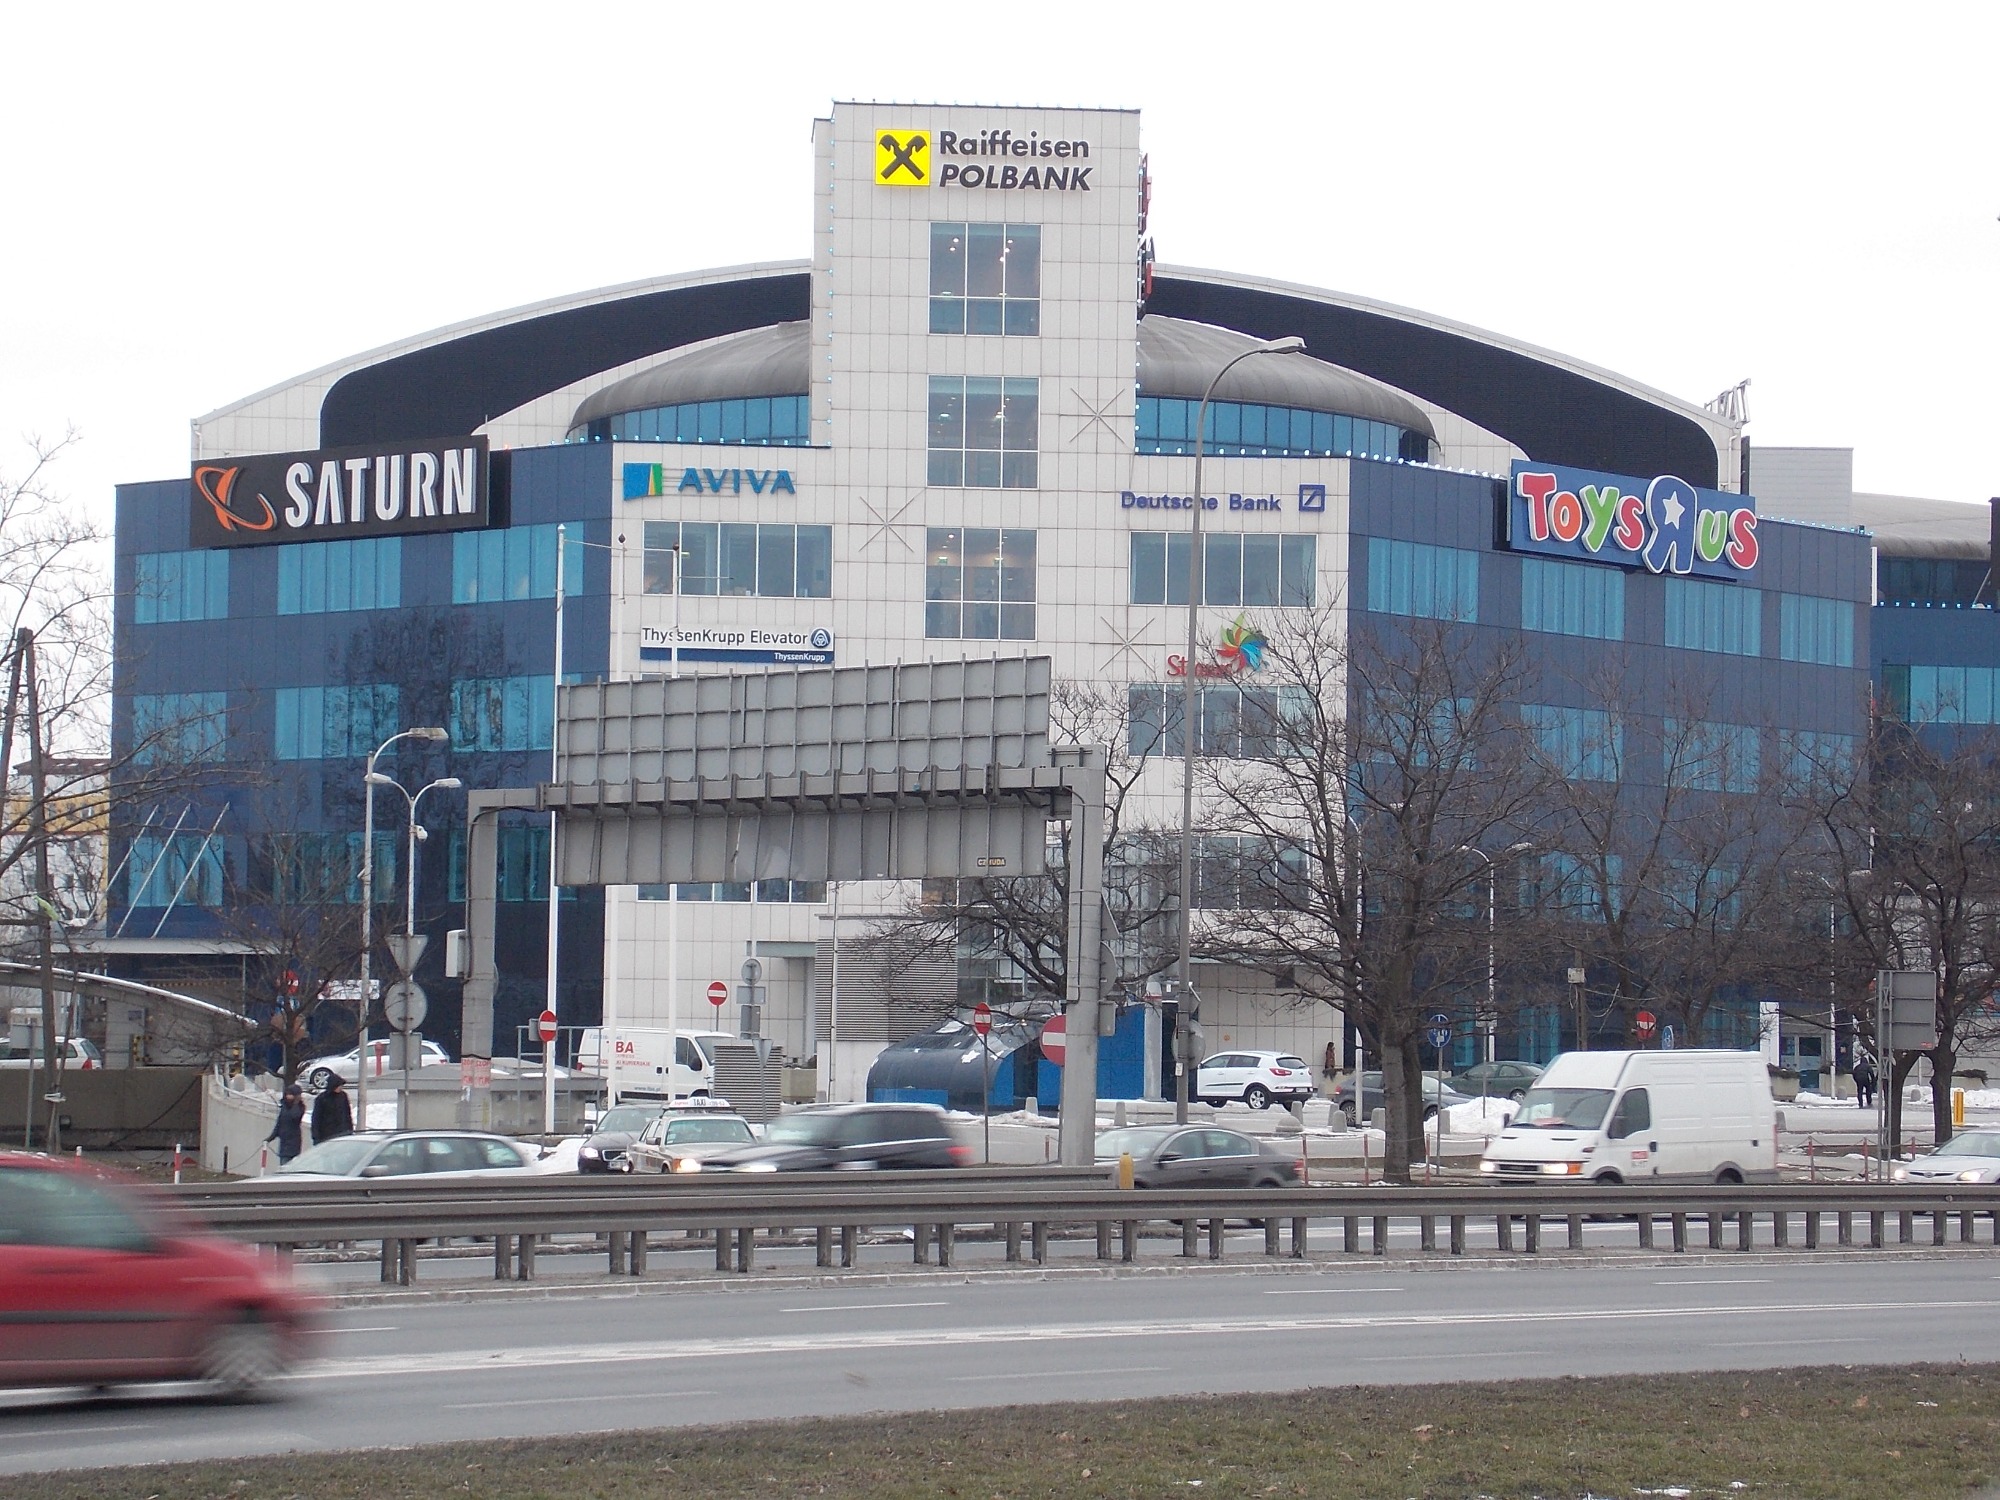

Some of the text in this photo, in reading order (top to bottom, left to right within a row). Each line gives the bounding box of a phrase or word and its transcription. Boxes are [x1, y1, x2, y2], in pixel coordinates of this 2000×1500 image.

[940, 130, 1089, 158] Raiffeisen
[939, 164, 1093, 191] POLBANK
[285, 448, 477, 528] SATURN
[678, 467, 796, 495] AVIVA
[1229, 493, 1281, 512] Bank
[750, 630, 808, 645] Elevator
[774, 652, 826, 662] ThyssenKrupp
[606, 1040, 634, 1054] BA
[693, 1098, 707, 1107] TAXI
